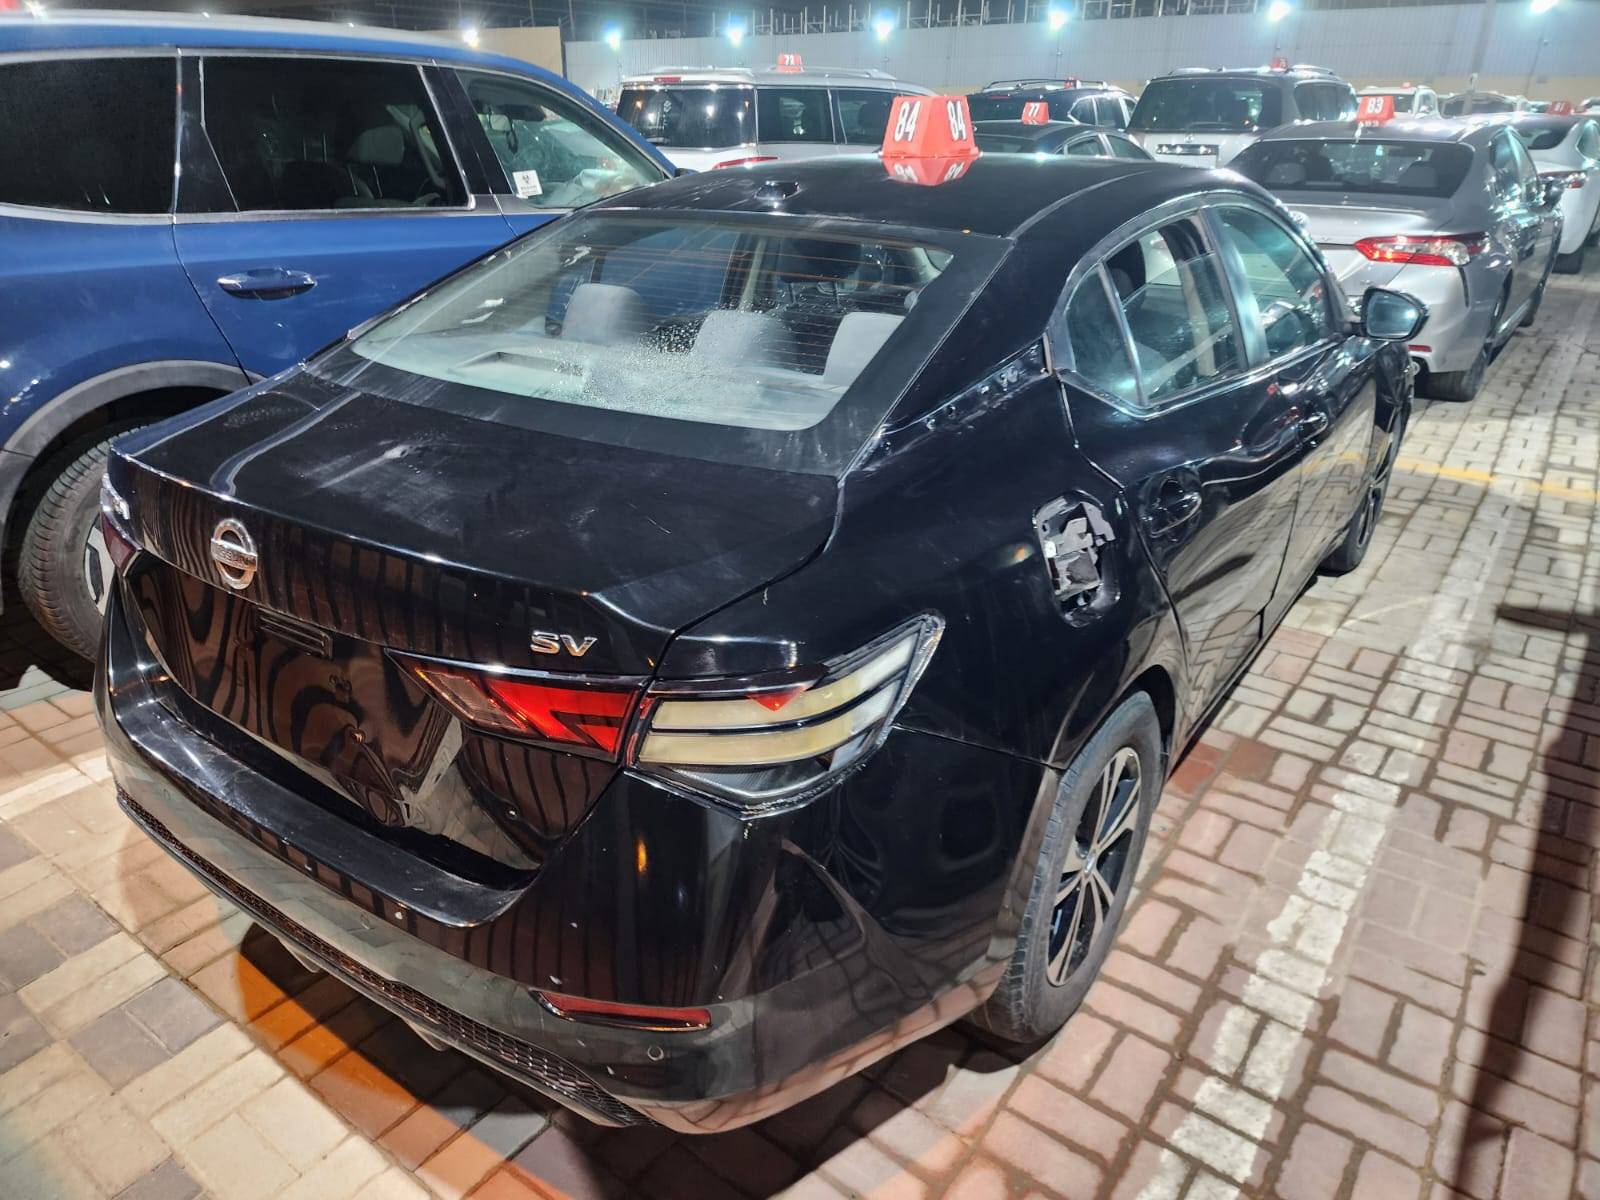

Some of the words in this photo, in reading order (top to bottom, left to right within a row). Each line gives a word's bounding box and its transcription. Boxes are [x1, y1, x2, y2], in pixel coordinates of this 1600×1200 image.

[1028, 102, 1041, 117] 77
[1367, 96, 1384, 114] 83
[894, 100, 921, 142] 84
[947, 100, 966, 141] 84
[530, 630, 598, 657] SV
